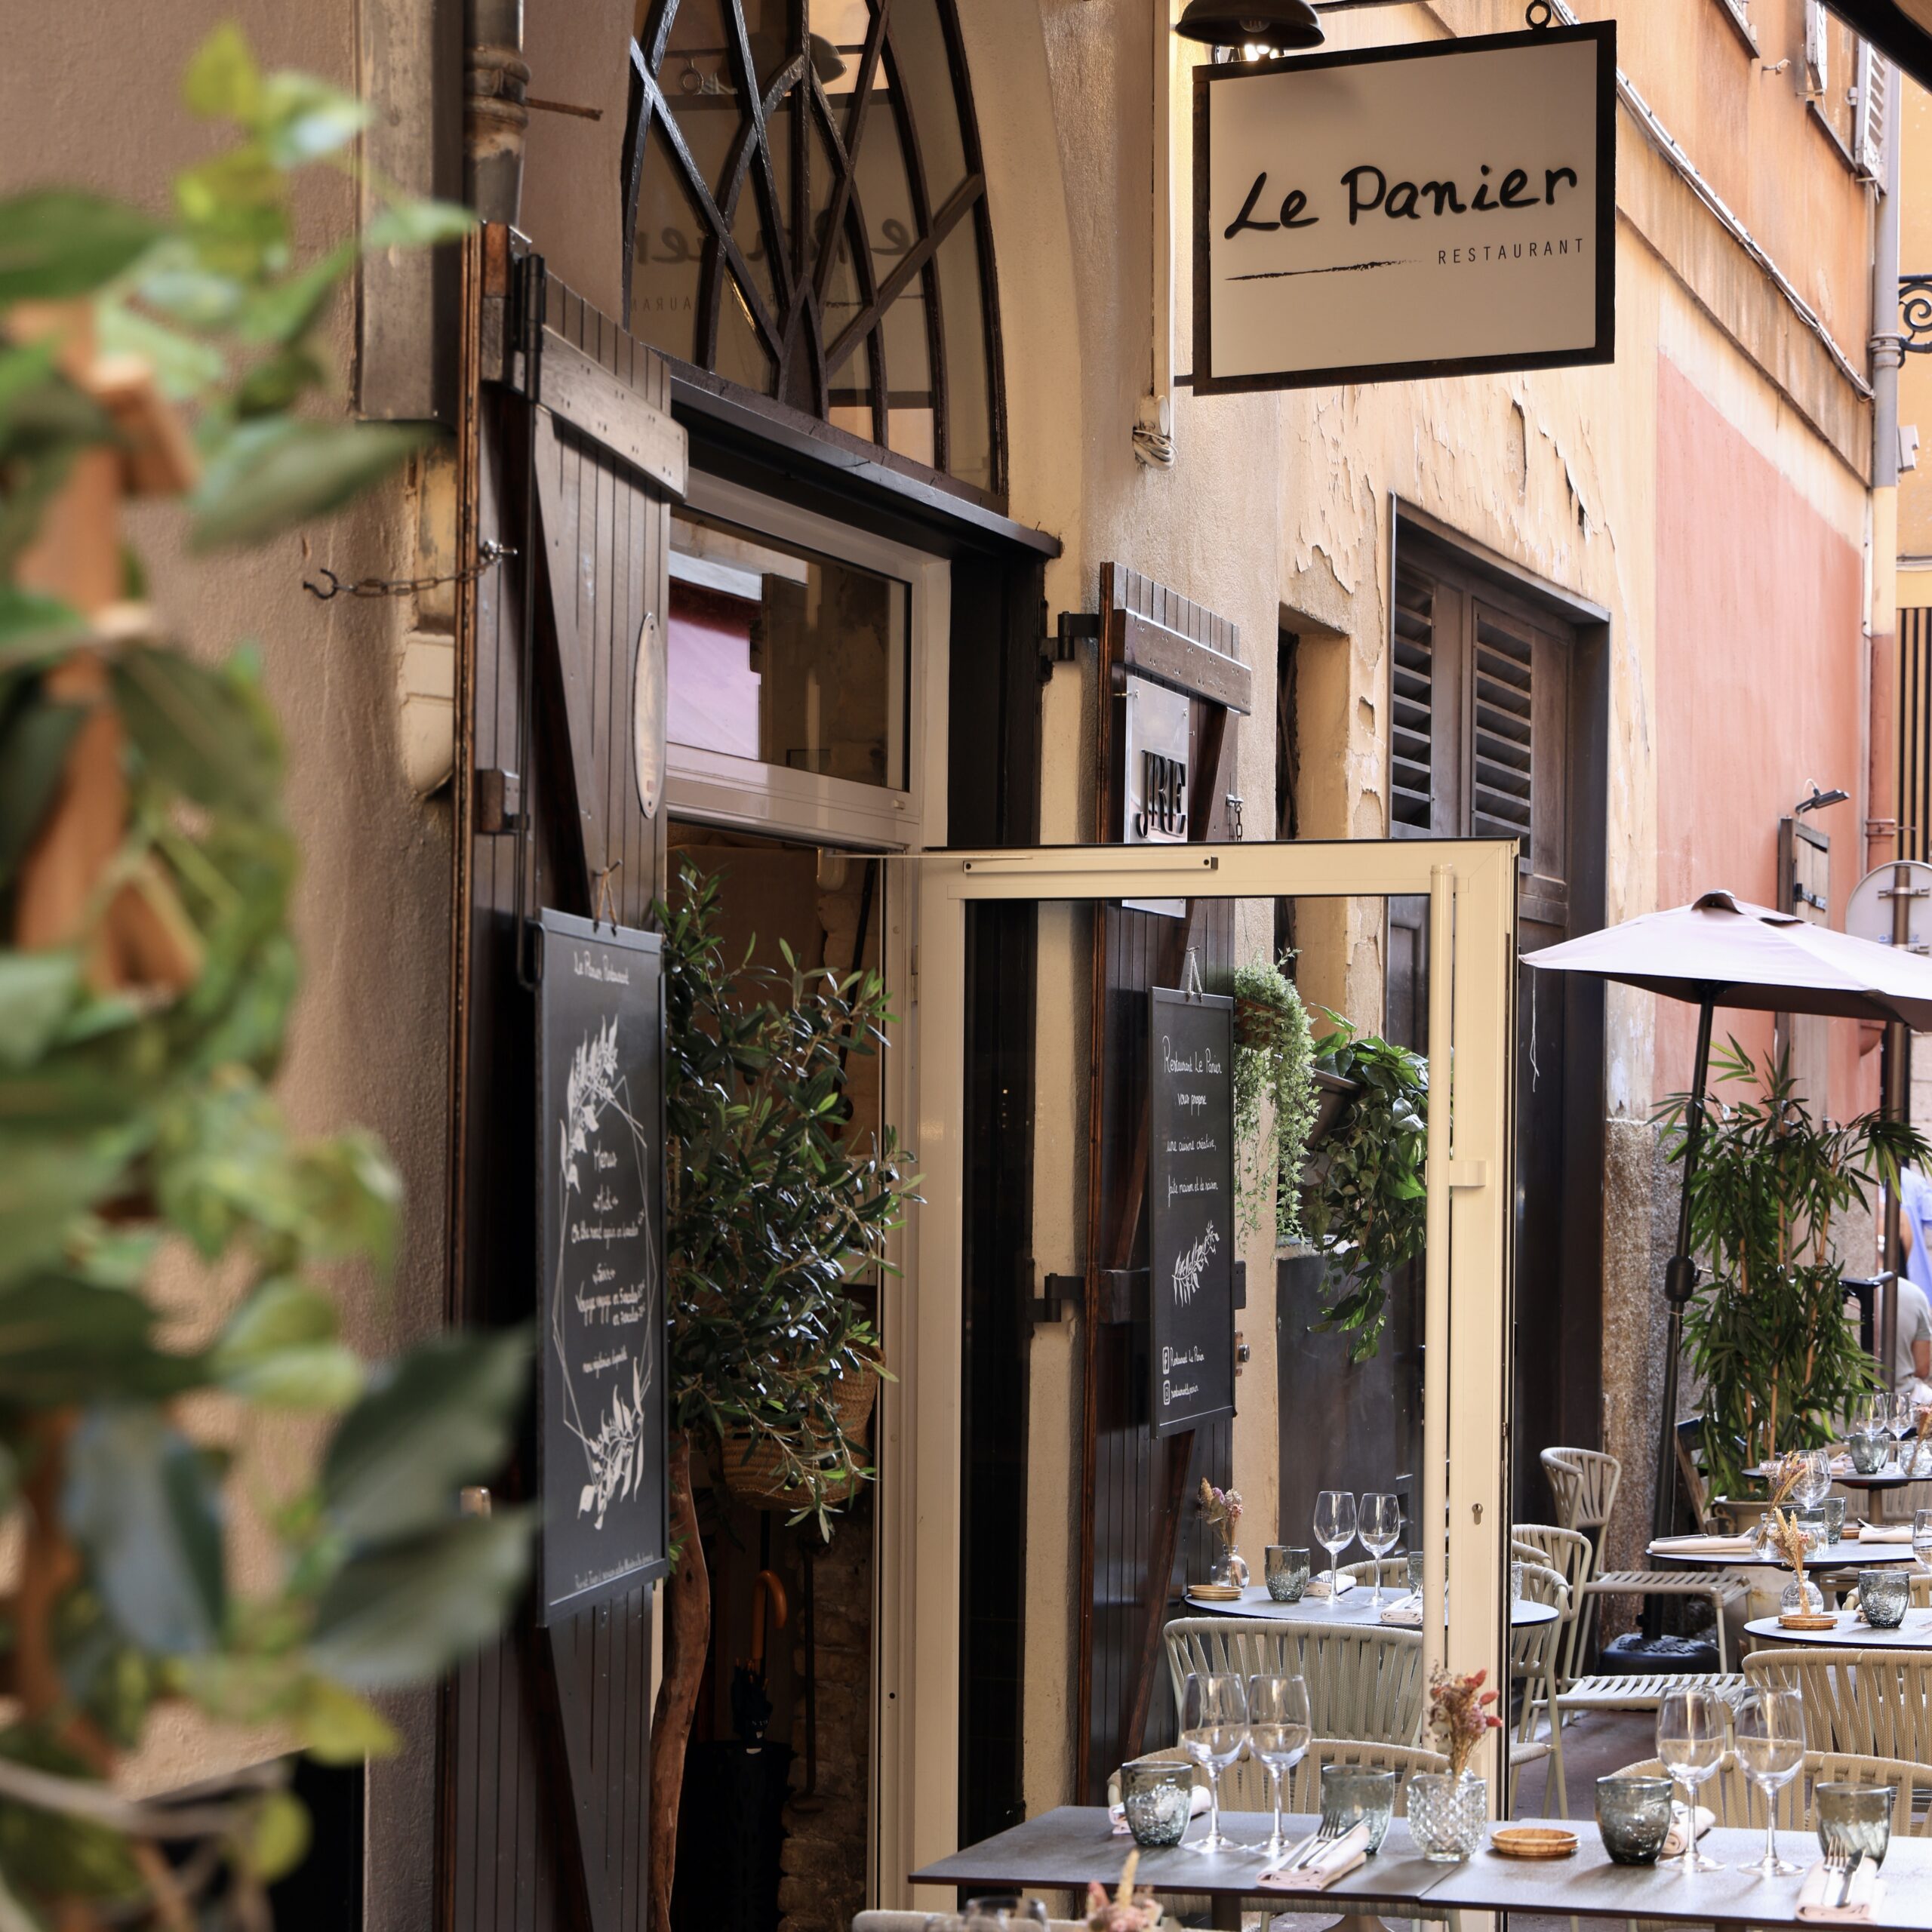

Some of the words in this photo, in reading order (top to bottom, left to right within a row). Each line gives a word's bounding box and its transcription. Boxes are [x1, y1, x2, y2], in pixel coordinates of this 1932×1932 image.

[1223, 172, 1319, 239] Le
[1340, 165, 1577, 226] Panier
[1438, 238, 1584, 265] RESTAURANT
[1162, 1035, 1192, 1072] Restaurant
[1195, 1051, 1204, 1073] Le
[1205, 1048, 1222, 1074] Panier
[1167, 1141, 1177, 1152] une
[1179, 1137, 1195, 1152] cuisine
[1179, 1177, 1194, 1193] maison
[1195, 1176, 1199, 1192] et
